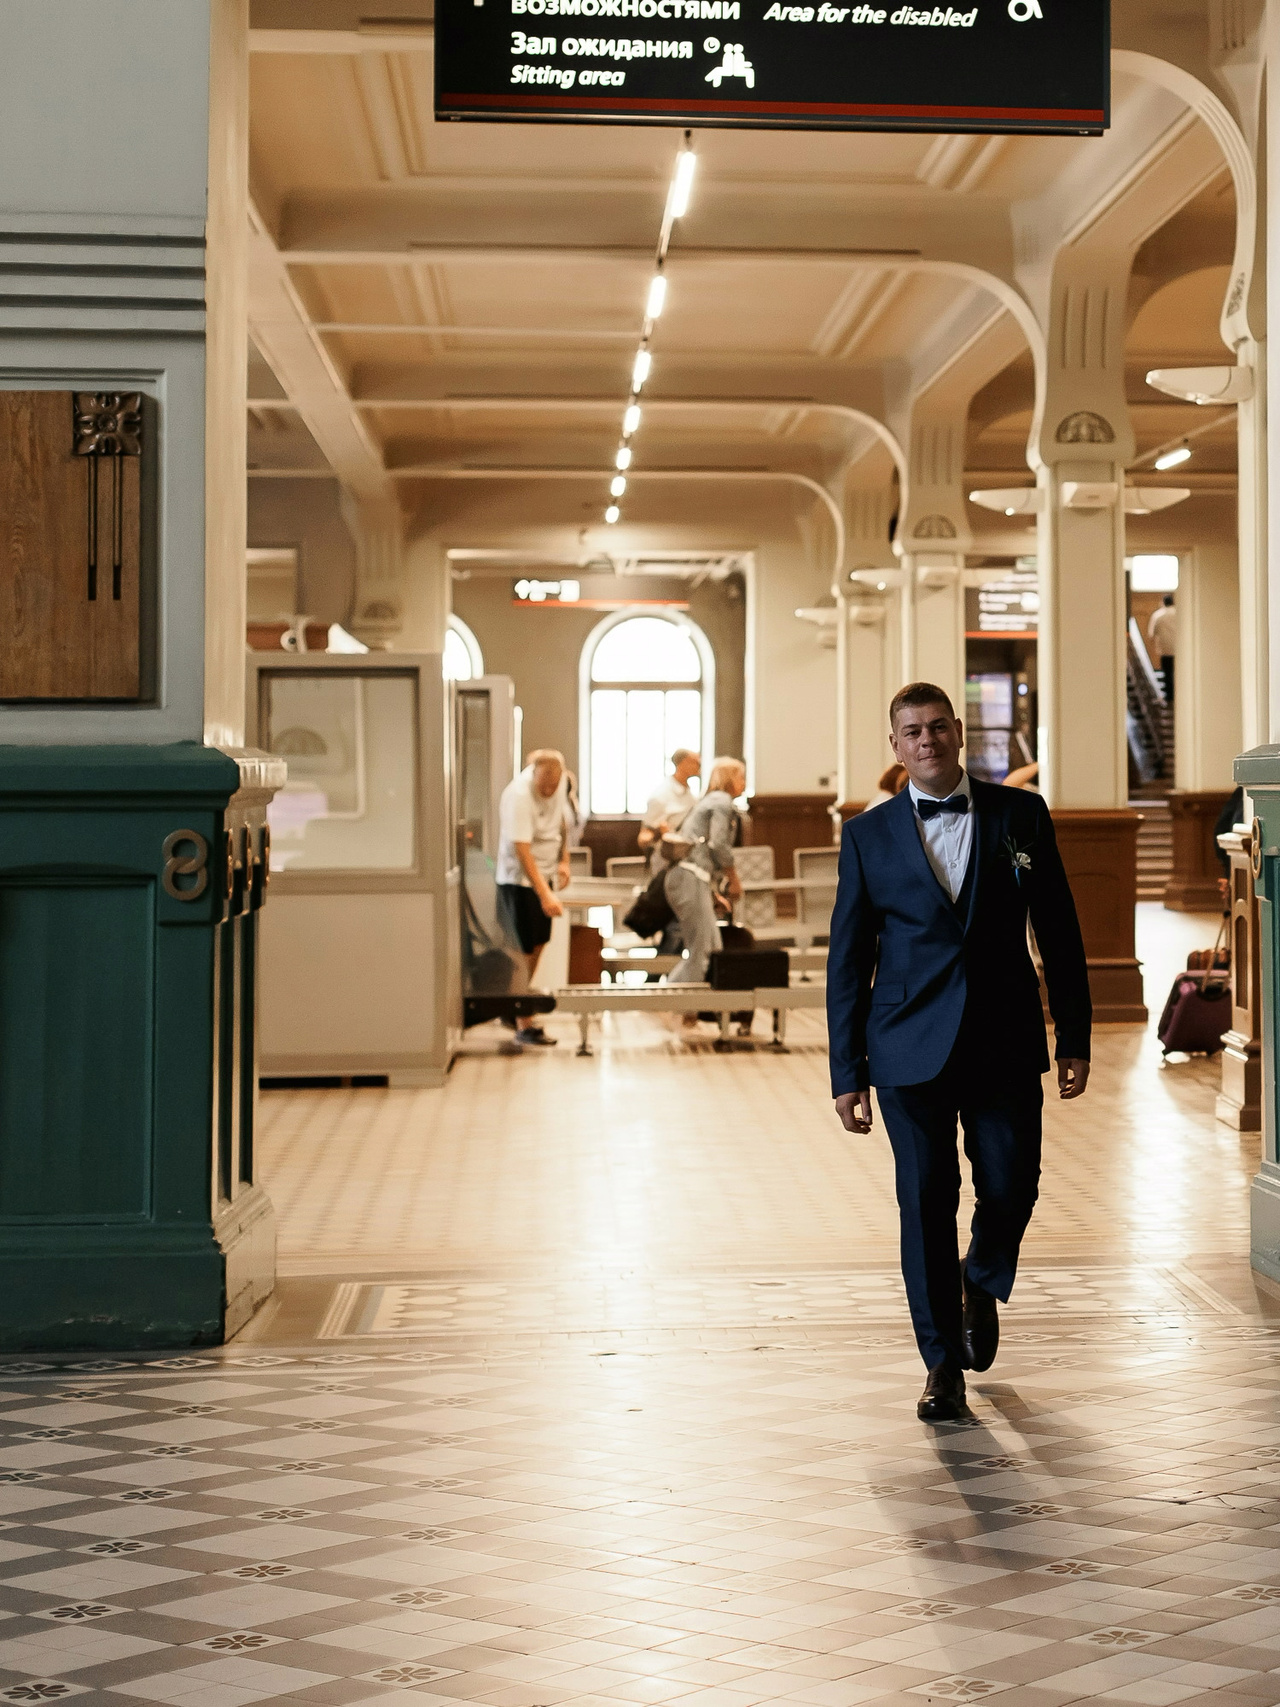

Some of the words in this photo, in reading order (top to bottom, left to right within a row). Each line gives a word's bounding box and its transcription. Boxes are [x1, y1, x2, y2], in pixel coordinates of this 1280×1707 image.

[511, 0, 741, 20] возможностями
[763, 2, 815, 23] Area
[817, 3, 851, 23] for
[851, 4, 888, 24] the
[889, 6, 979, 27] disabled
[510, 31, 557, 56] Зал
[561, 37, 694, 60] ожидания
[510, 64, 577, 90] Sitting
[578, 69, 626, 87] area
